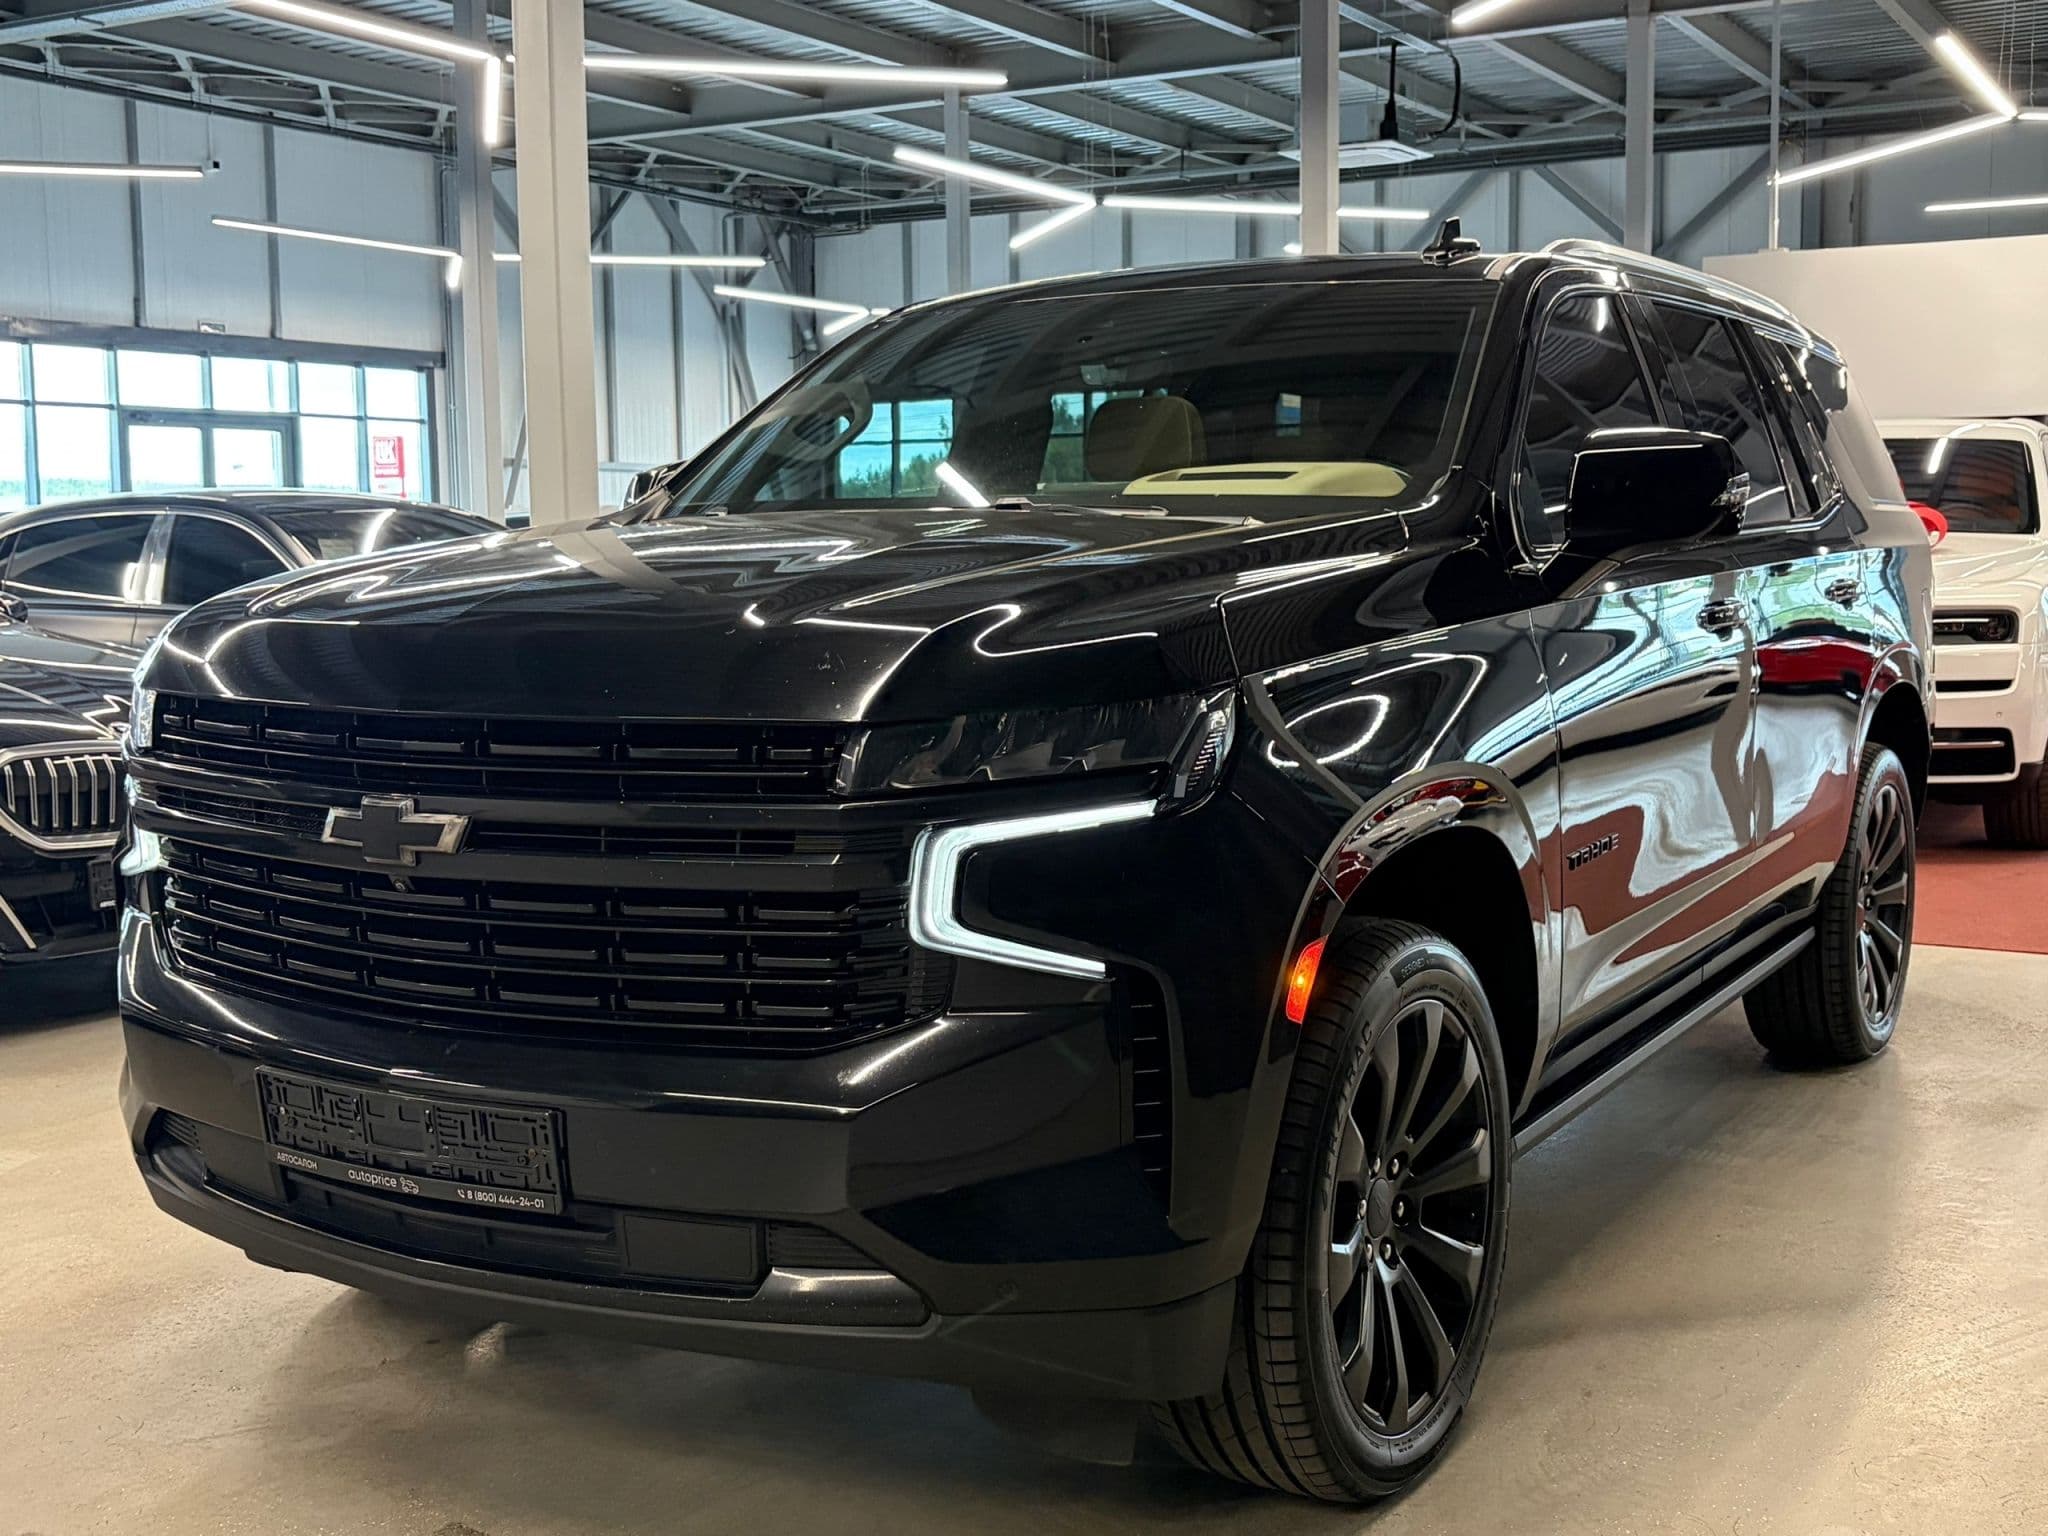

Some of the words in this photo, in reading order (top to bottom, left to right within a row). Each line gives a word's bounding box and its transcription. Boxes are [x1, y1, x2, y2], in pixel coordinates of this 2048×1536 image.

[1566, 833, 1619, 870] TAHOE
[276, 1151, 318, 1170] АВТОСАЛОН
[348, 1169, 398, 1188] autoprice
[467, 1190, 473, 1200] 8
[474, 1190, 497, 1203] (800)
[498, 1192, 545, 1209] 444-24-01
